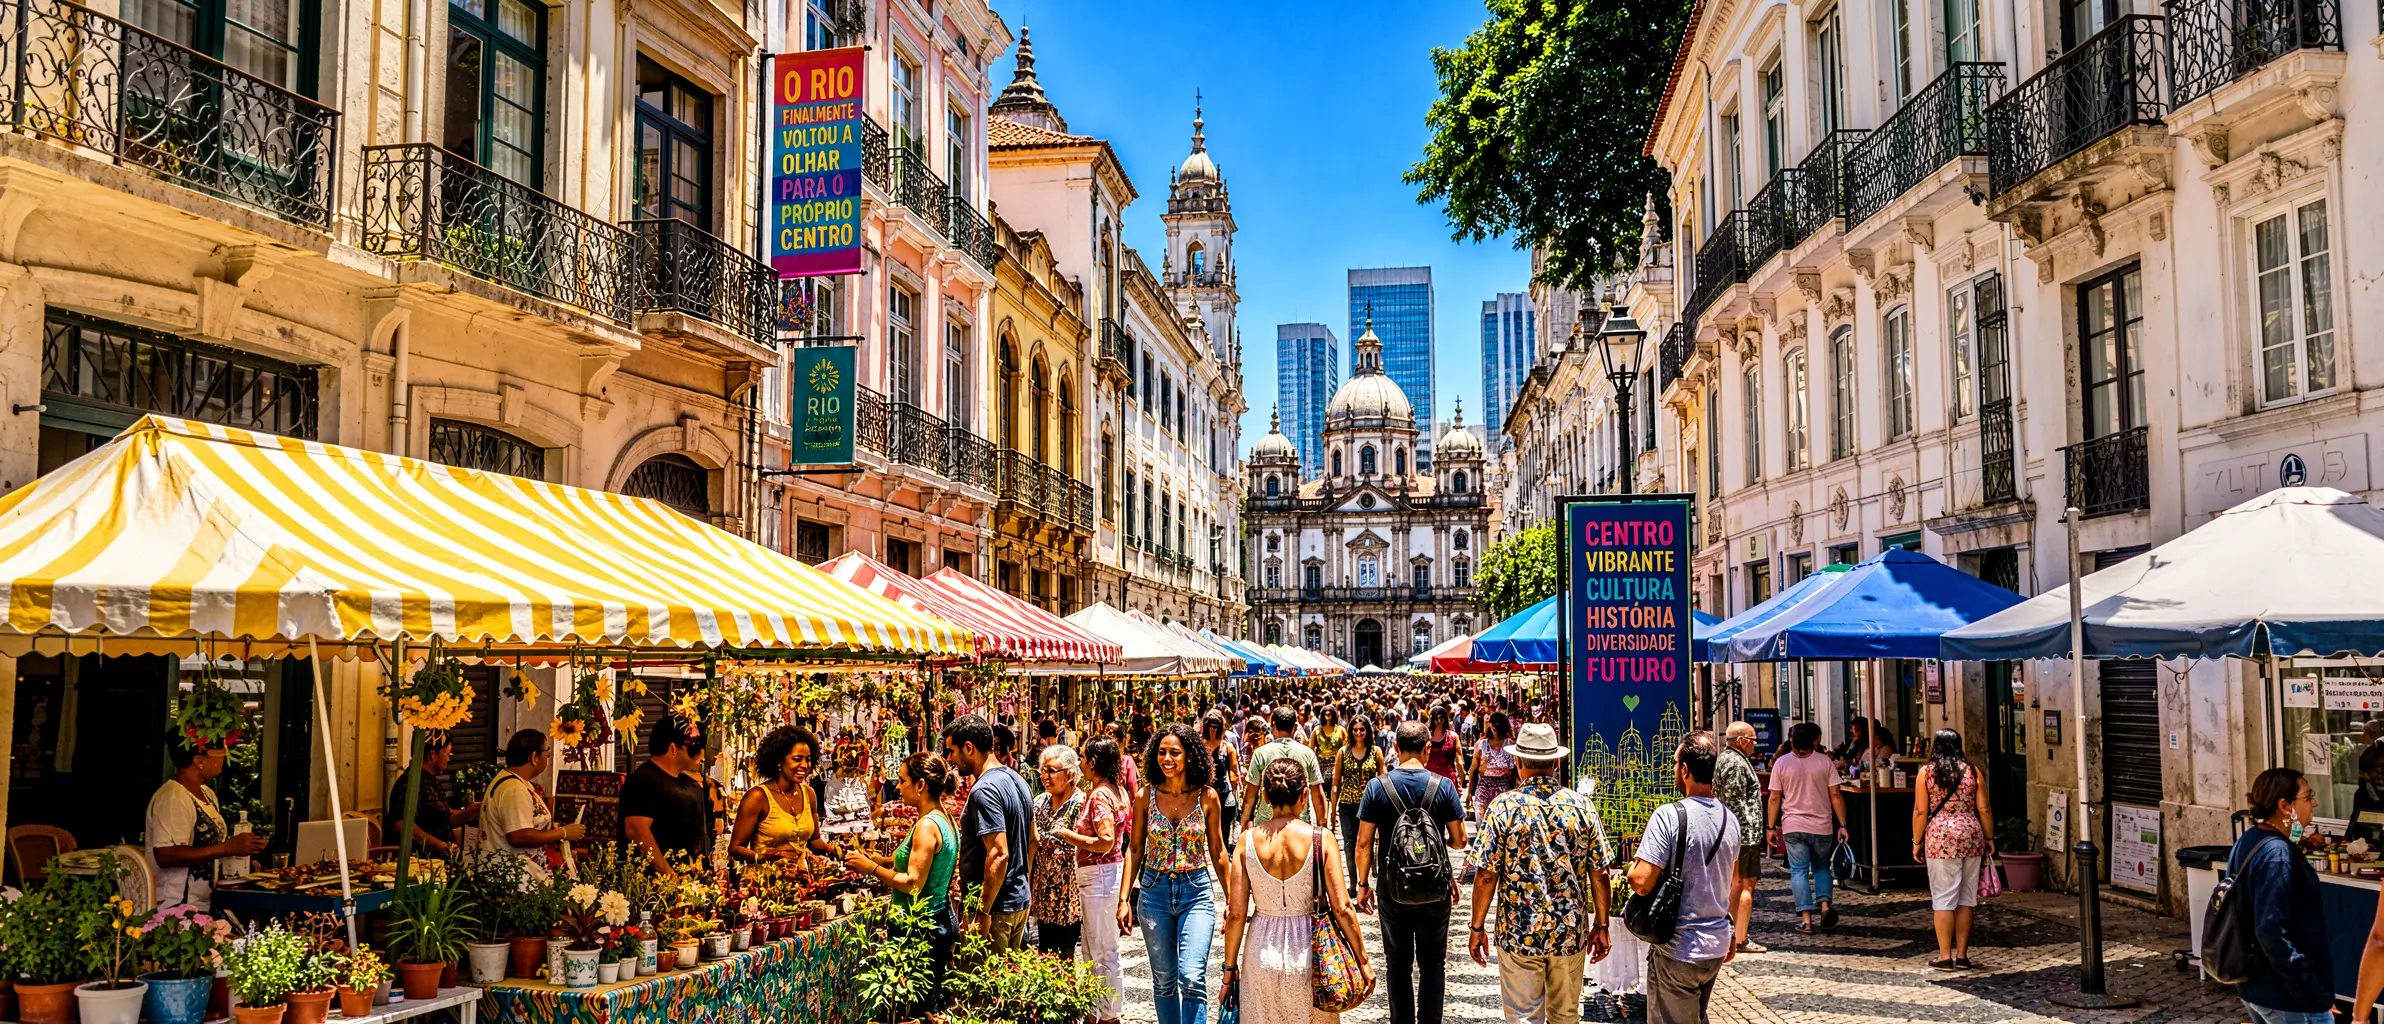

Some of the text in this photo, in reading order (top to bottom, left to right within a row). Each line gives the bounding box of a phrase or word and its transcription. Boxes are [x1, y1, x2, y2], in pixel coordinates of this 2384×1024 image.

[784, 66, 854, 103] O RIO
[782, 102, 855, 126] FINALMENTE
[783, 124, 853, 149] VOLTOU A
[782, 150, 840, 175] OLHAR
[782, 174, 843, 200] PARA O
[781, 199, 853, 225] PRÓPRIO
[780, 223, 853, 250] CENTRO
[807, 397, 840, 415] RIO
[1585, 520, 1674, 546] CENTRO
[1585, 550, 1675, 572] VIBRANTE
[1586, 577, 1675, 601] CULTURA
[1586, 601, 1675, 629] HISTÓRIA
[1587, 634, 1676, 651] DIVERSIDADE
[1587, 656, 1676, 683] FUTURO
